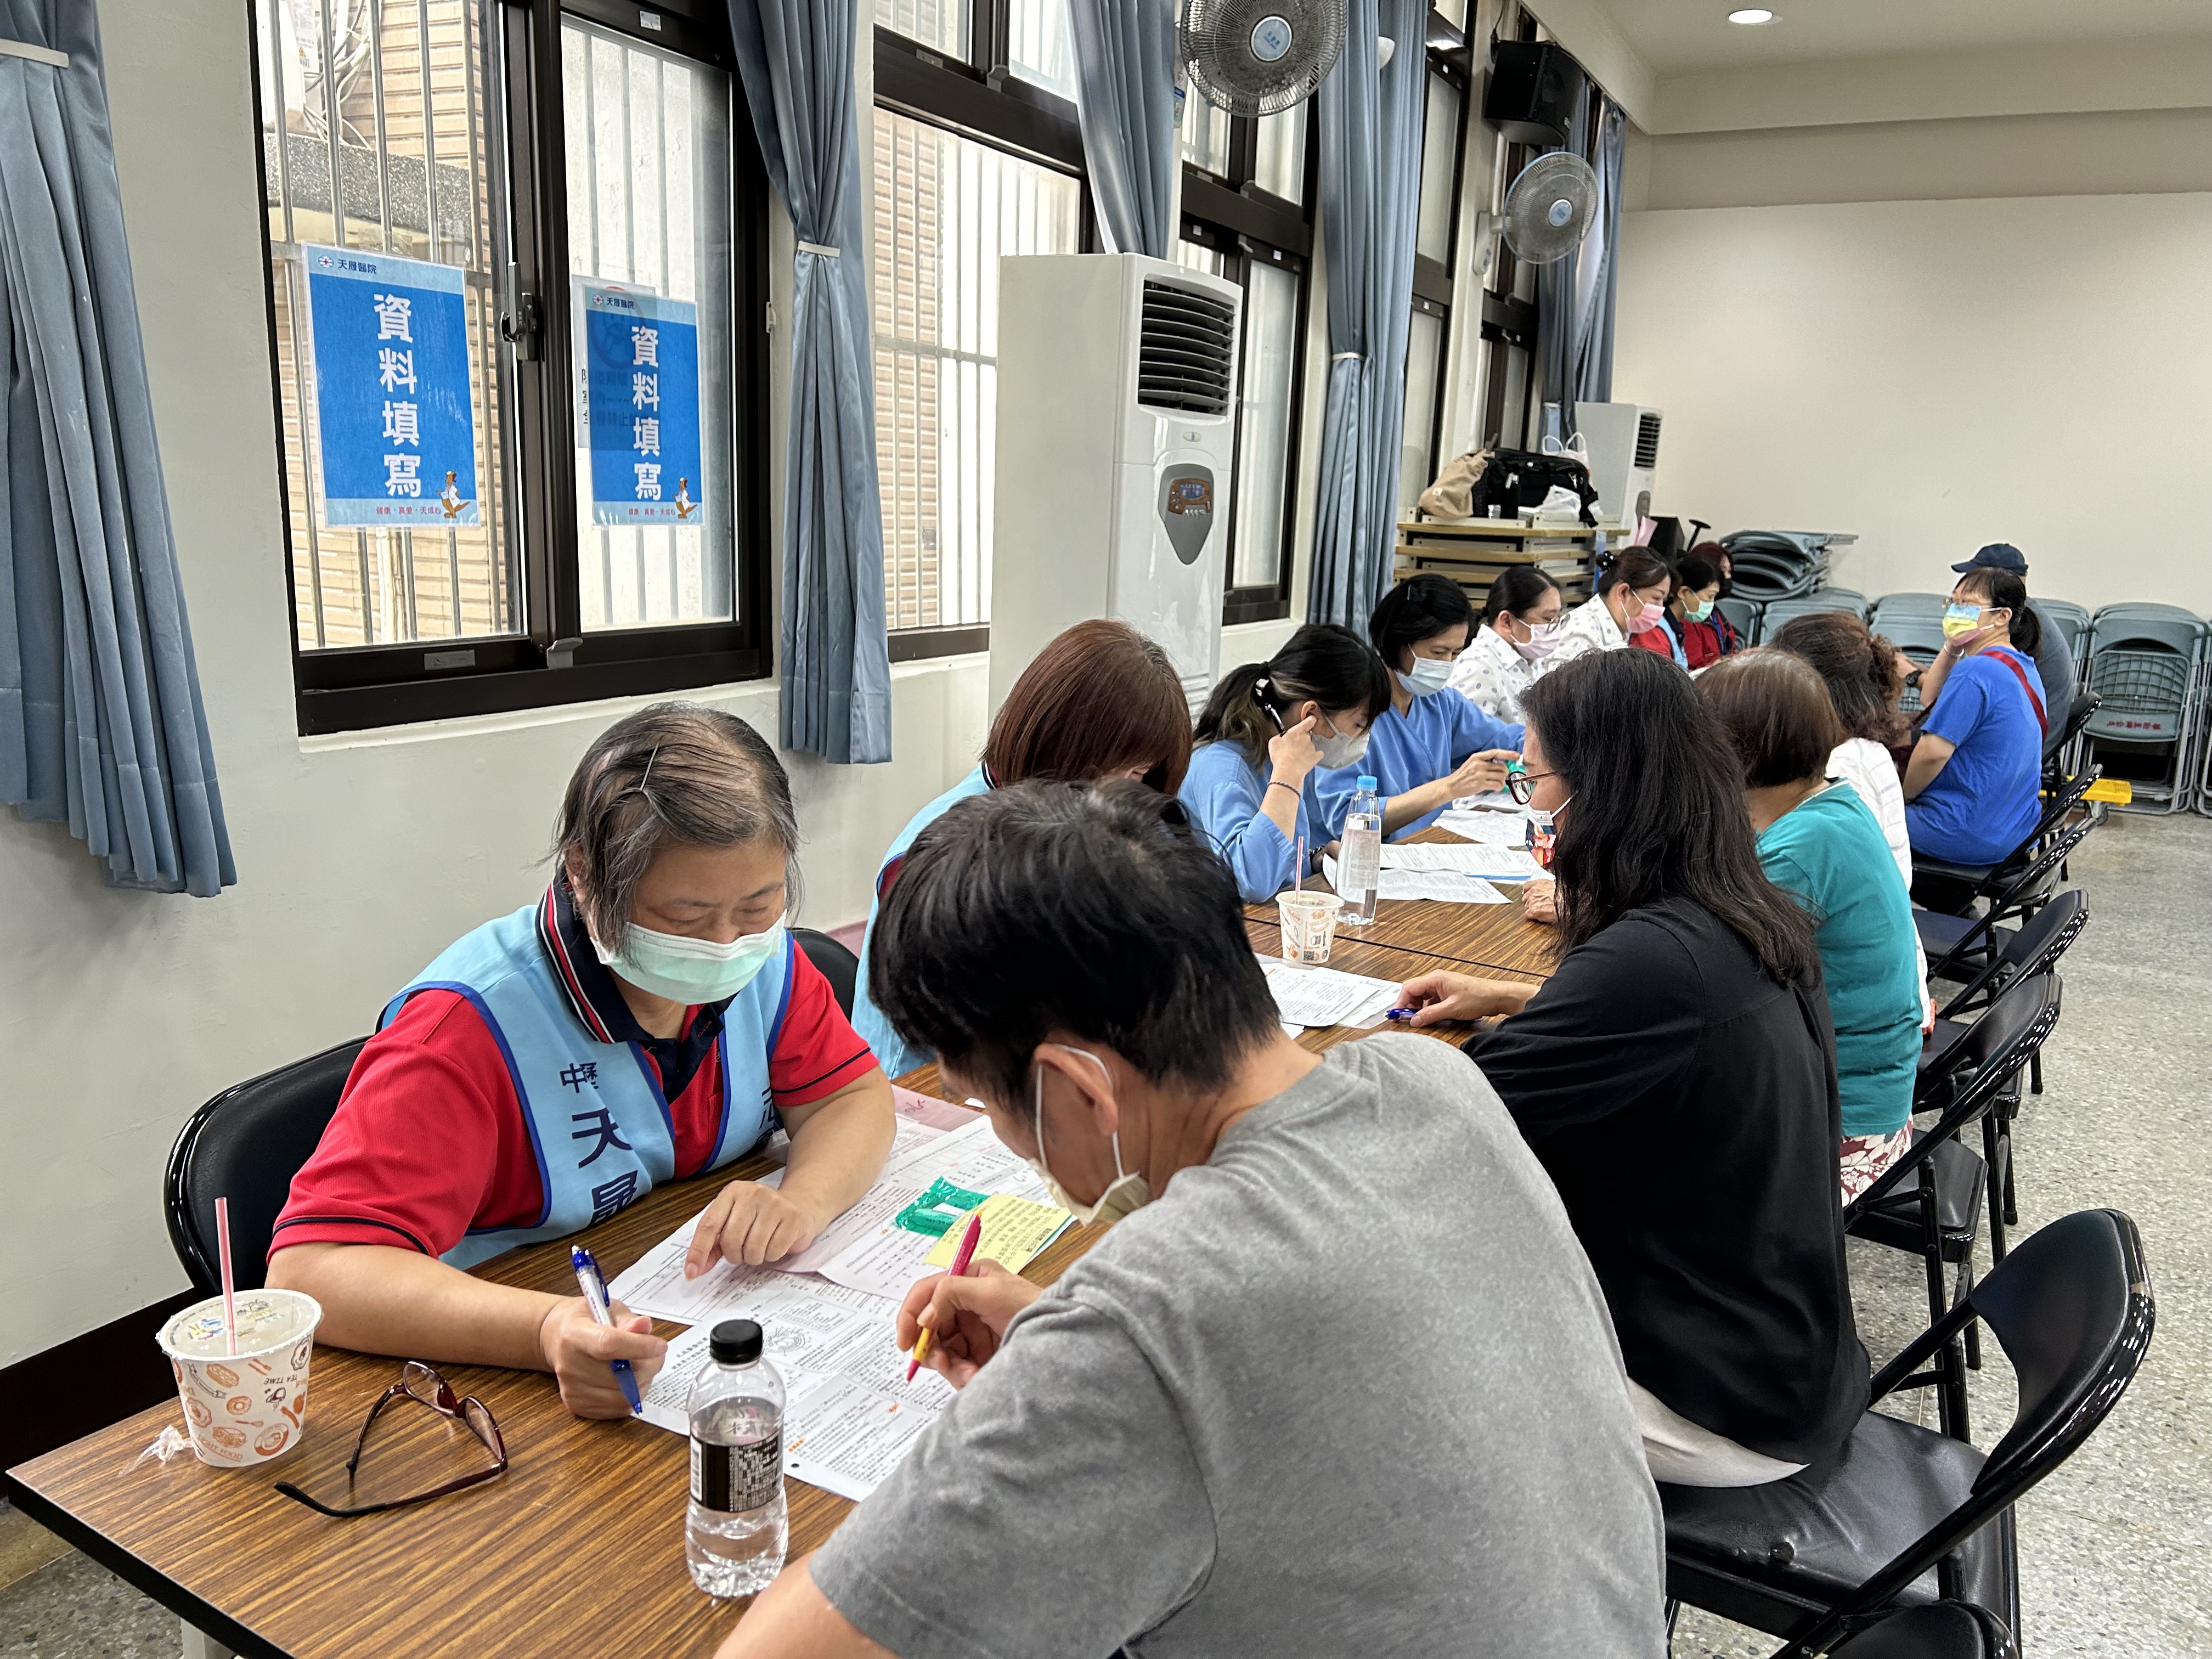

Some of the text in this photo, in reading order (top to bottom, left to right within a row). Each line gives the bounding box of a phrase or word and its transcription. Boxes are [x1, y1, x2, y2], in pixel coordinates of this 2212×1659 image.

[337, 258, 377, 274] 天晟醫院
[606, 297, 635, 309] 天晟醫院
[374, 293, 421, 498] 資料填寫
[631, 325, 661, 501] 資料填寫
[263, 1377, 284, 1385] TIME
